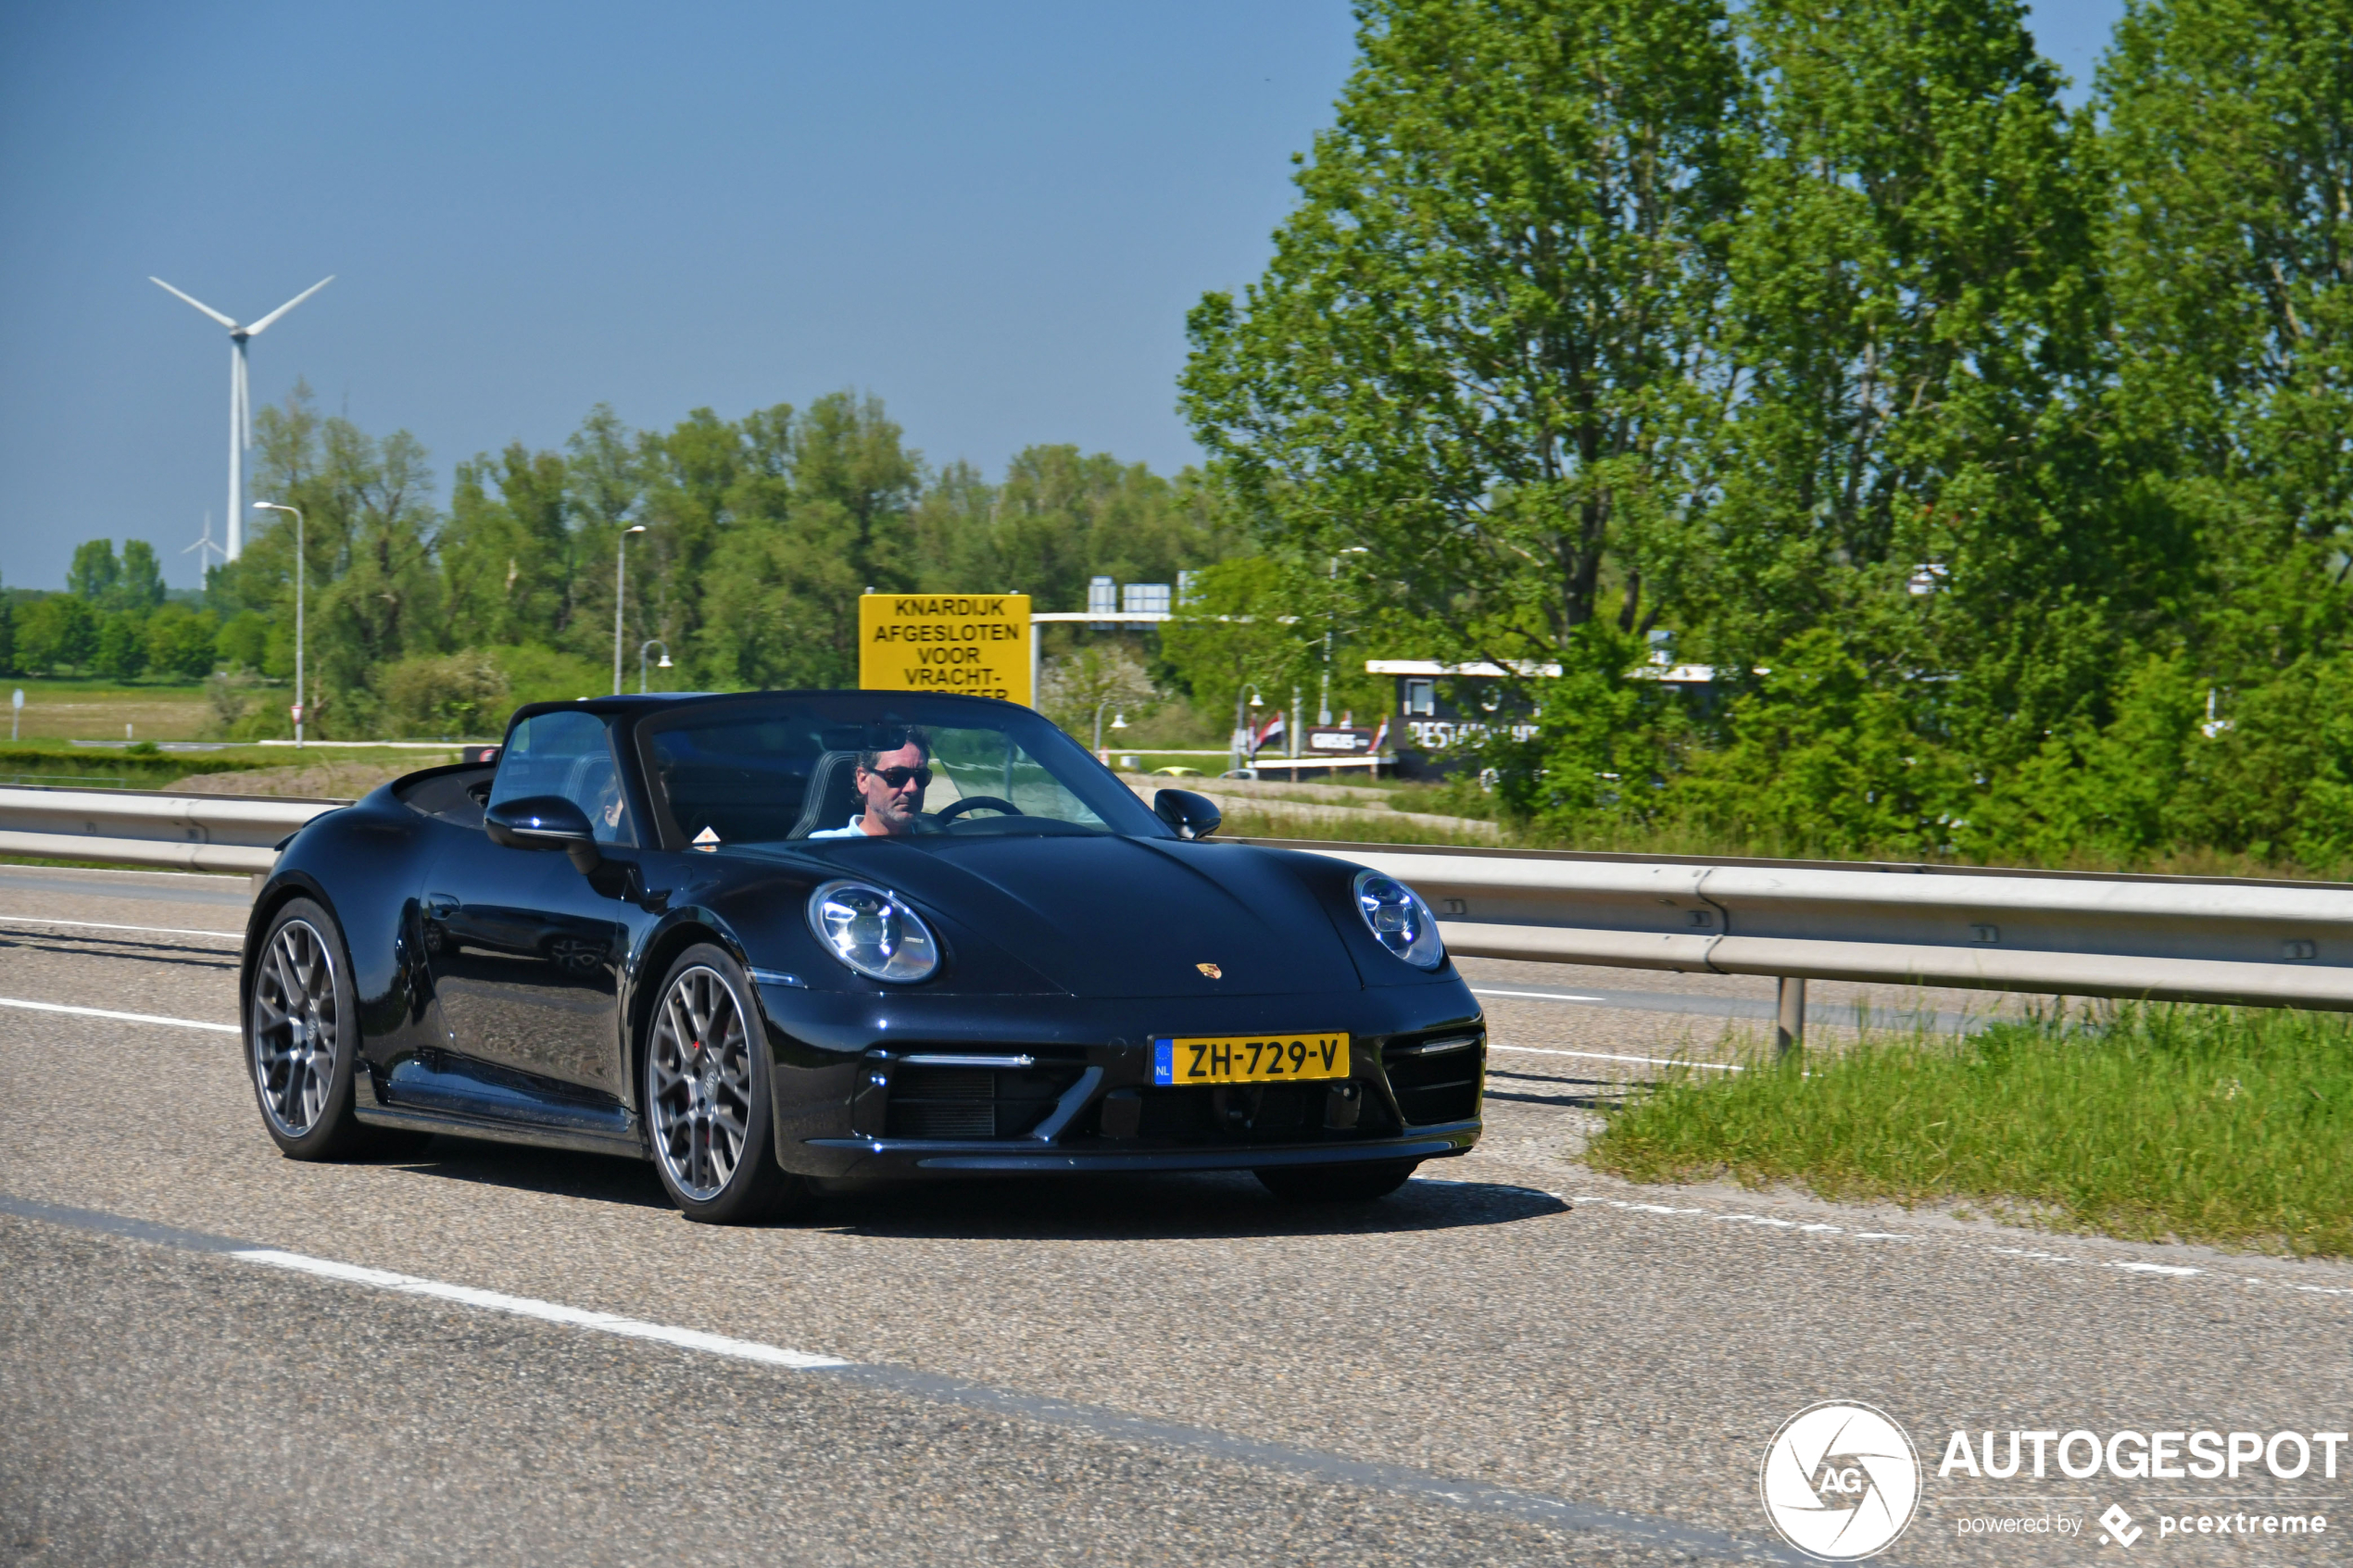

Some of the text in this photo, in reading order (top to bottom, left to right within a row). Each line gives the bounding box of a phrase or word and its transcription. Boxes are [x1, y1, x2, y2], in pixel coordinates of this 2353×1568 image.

[895, 599, 1005, 617] KNARDIJK
[874, 624, 1019, 642] AFGESLOTEN
[917, 646, 980, 665] VOOR
[904, 668, 1002, 685] VRACHT-
[1188, 1039, 1338, 1077] ZH-729-V
[1156, 1066, 1169, 1076] NL
